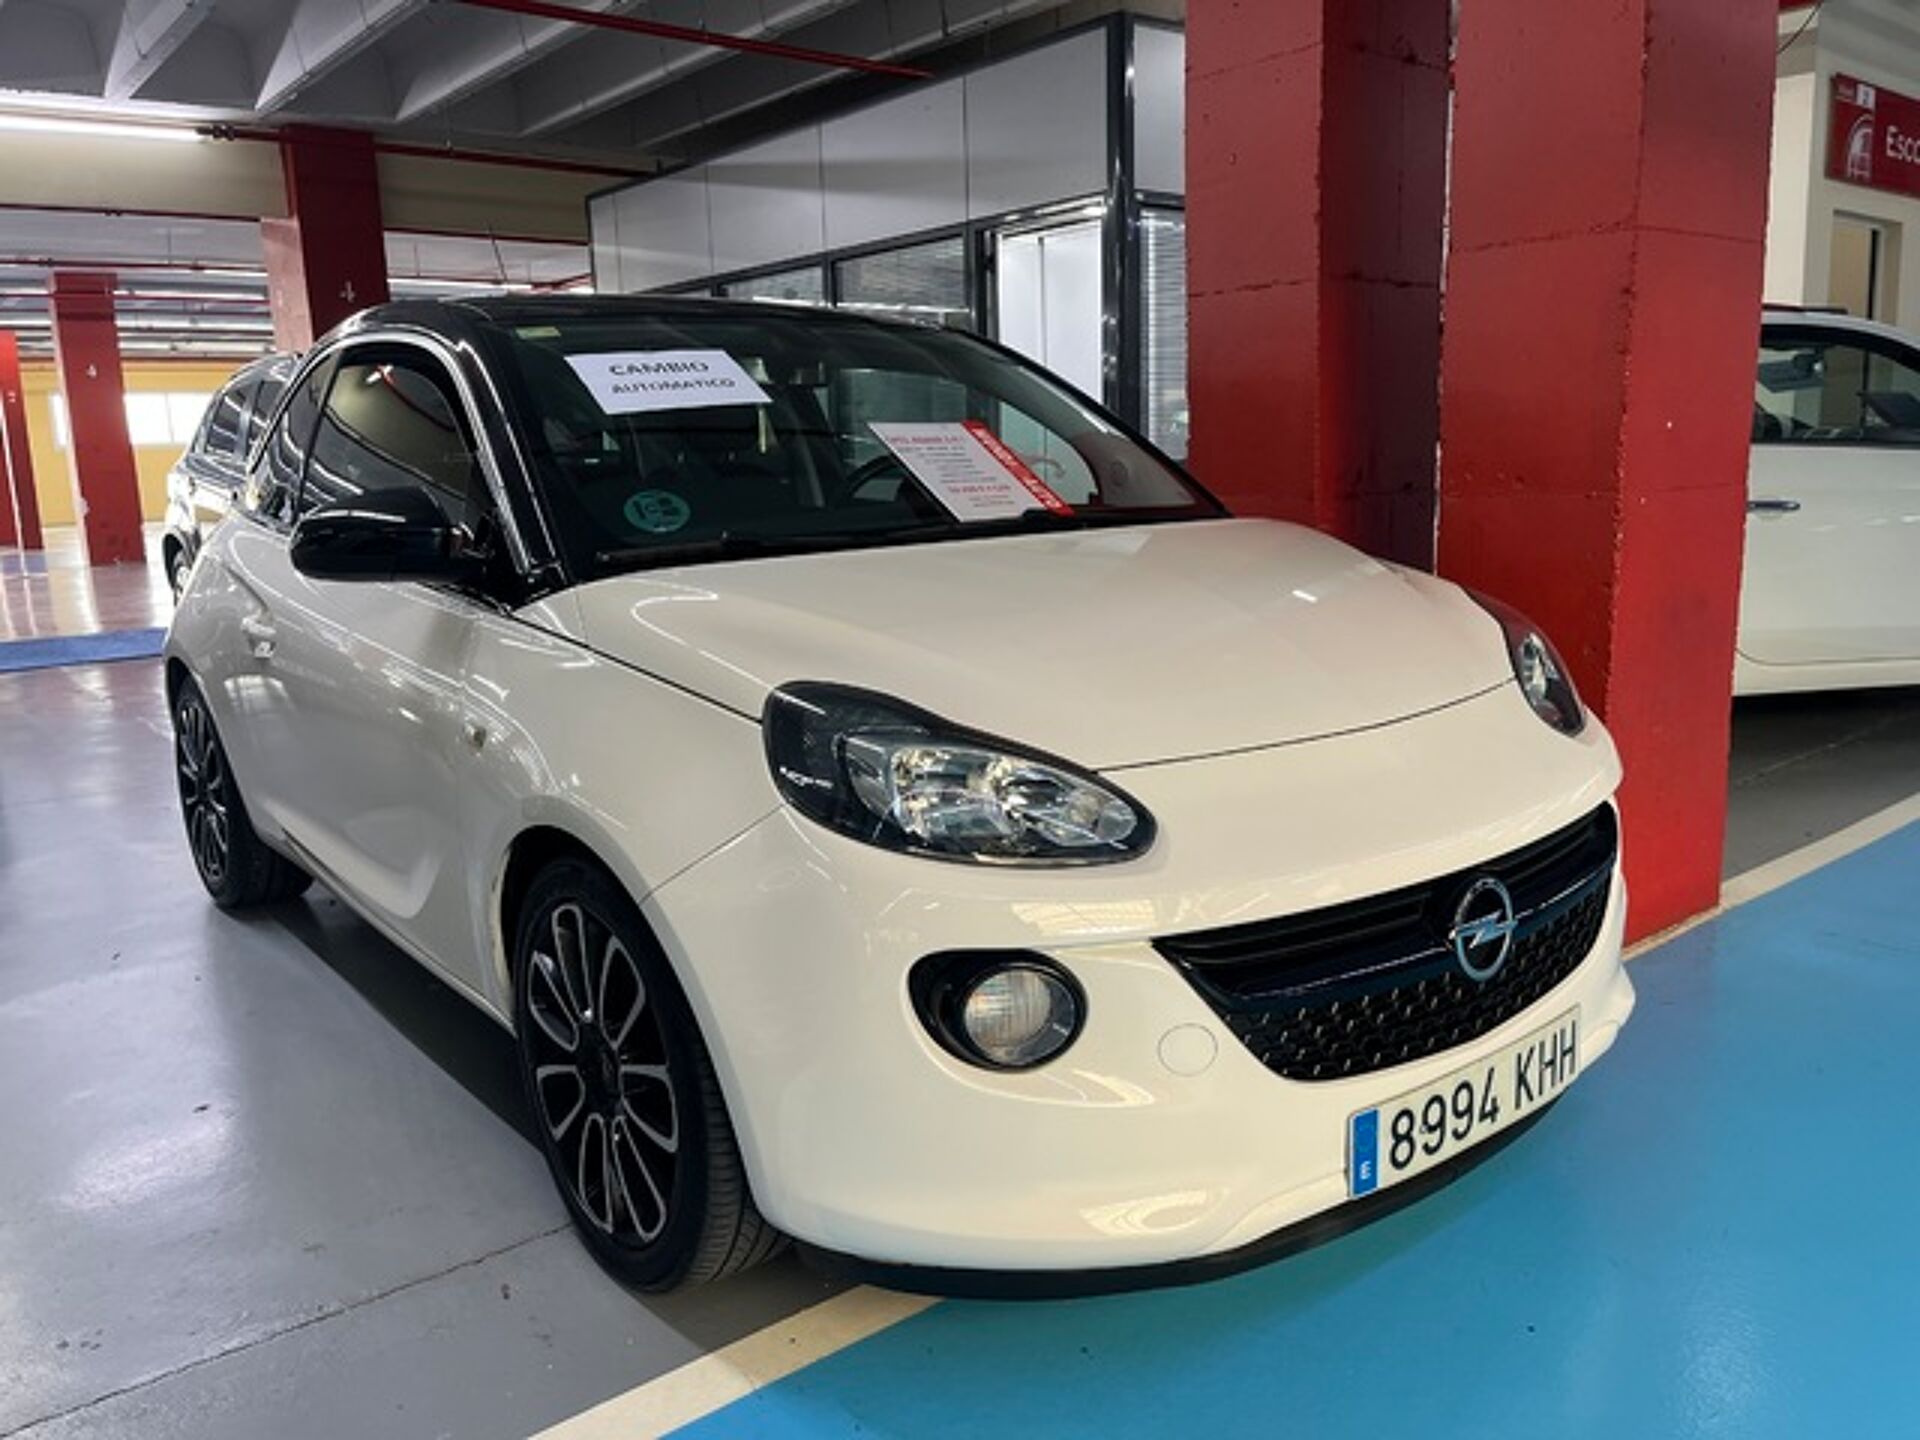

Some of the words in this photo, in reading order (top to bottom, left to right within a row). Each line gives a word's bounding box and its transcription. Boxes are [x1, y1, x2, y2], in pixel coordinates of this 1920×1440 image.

[609, 361, 709, 376] CAMBIO
[1389, 1066, 1500, 1170] 8994
[1514, 1019, 1577, 1110] KHH
